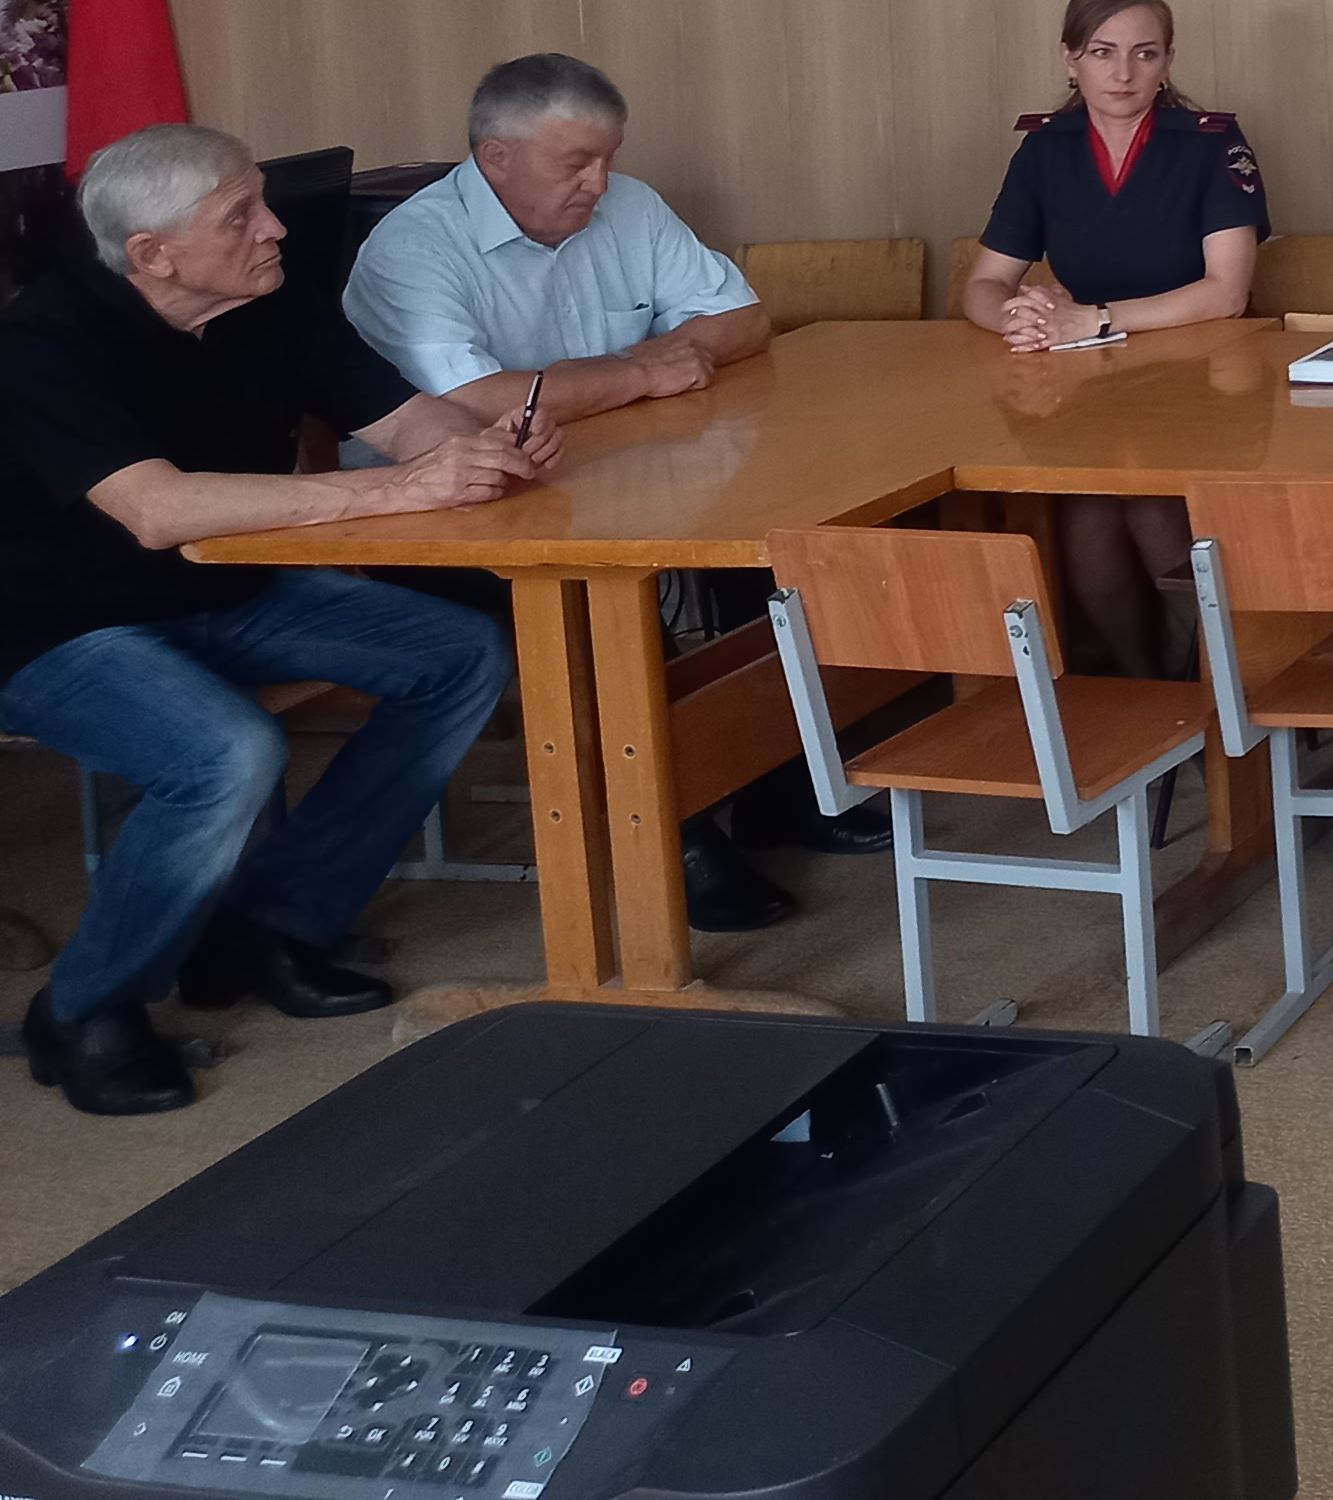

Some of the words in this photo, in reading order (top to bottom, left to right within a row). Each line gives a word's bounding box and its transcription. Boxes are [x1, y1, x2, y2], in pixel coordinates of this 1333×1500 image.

[165, 1311, 188, 1324] ON
[172, 1351, 210, 1365] HOME
[469, 1347, 482, 1362] 1
[502, 1350, 516, 1364] 2
[537, 1354, 549, 1367] 3
[448, 1382, 461, 1395] 4
[482, 1385, 494, 1398] 5
[517, 1388, 530, 1401] 6
[426, 1417, 440, 1429] 7
[461, 1420, 474, 1433] 8
[496, 1423, 508, 1436] 9
[365, 1428, 388, 1442] OK
[437, 1456, 451, 1471] 0
